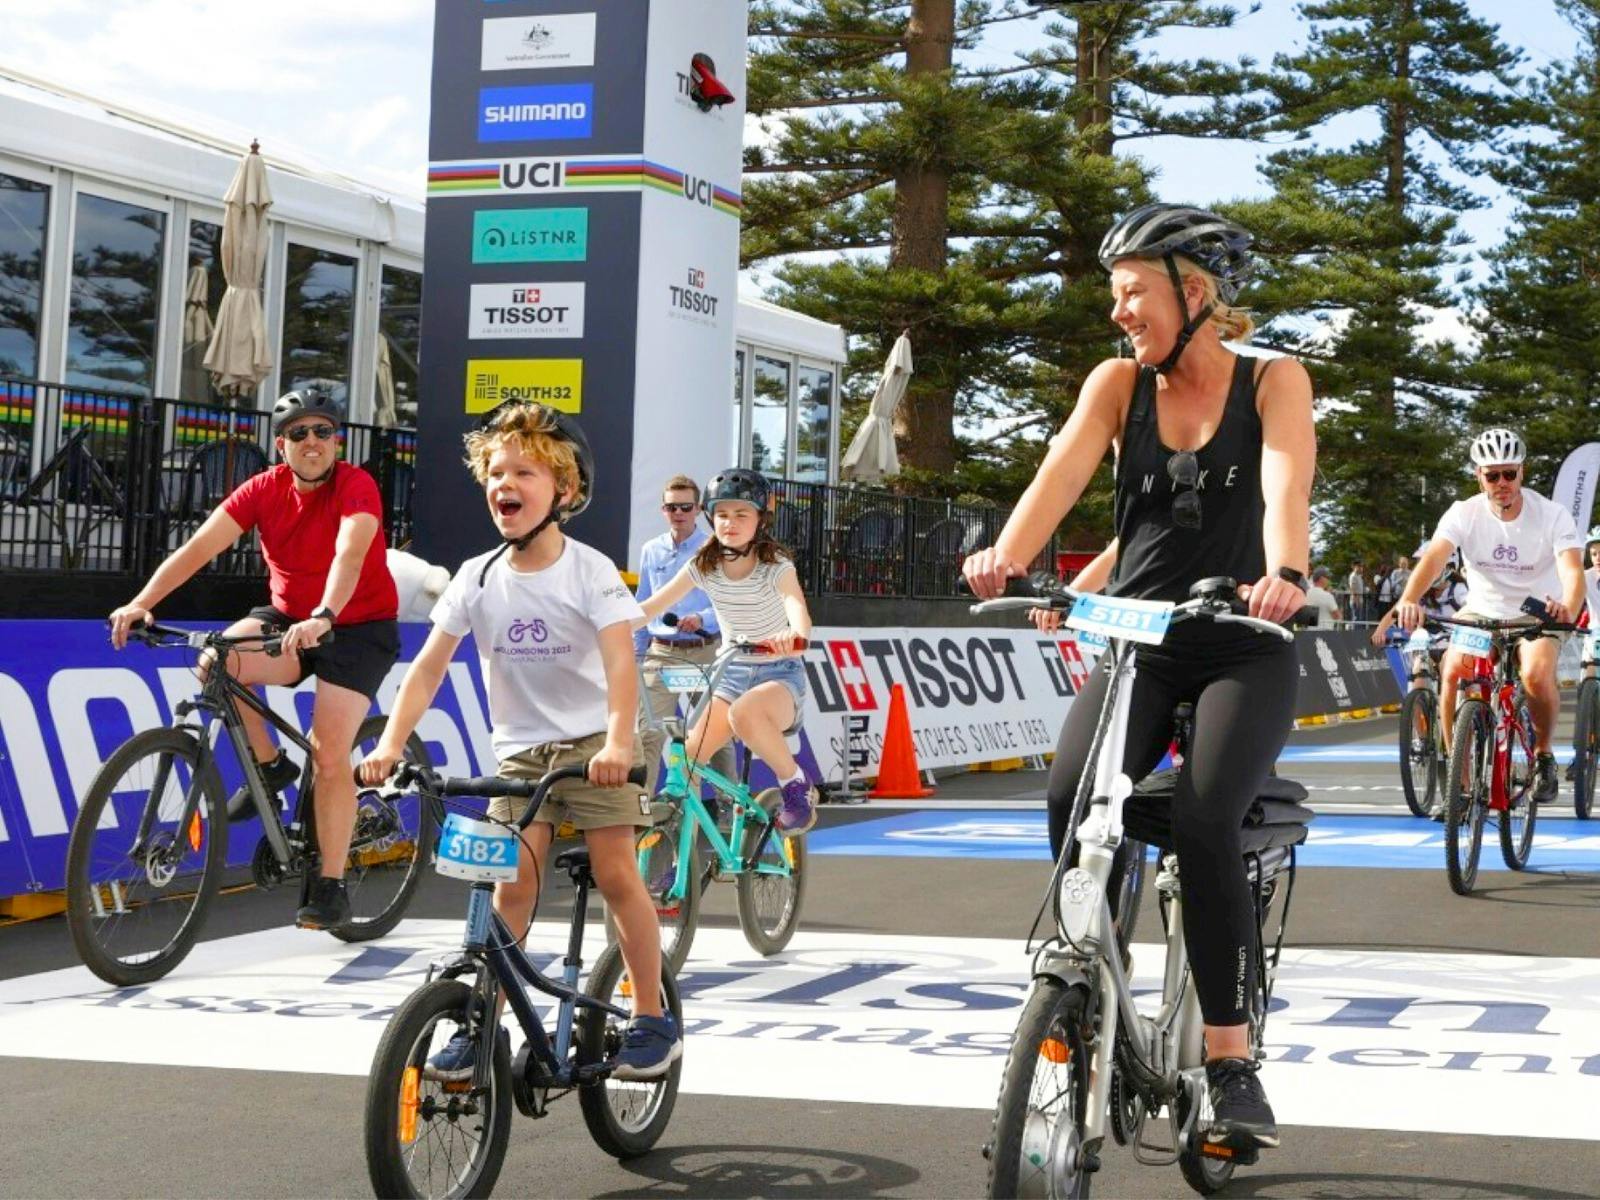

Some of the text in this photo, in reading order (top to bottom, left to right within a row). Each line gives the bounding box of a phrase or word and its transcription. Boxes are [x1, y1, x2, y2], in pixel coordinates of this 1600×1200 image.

[484, 103, 586, 123] SHIMANO
[502, 162, 562, 189] UCI
[684, 174, 713, 207] UCI
[484, 306, 569, 324] TISSOT
[669, 284, 718, 317] TISSOT
[500, 387, 571, 399] SOUTH32
[1572, 470, 1586, 518] SOUTH32
[1088, 605, 1153, 630] 5181
[859, 637, 1027, 710] TISSOT
[968, 721, 1017, 753] SINCE
[447, 834, 506, 864] 5182
